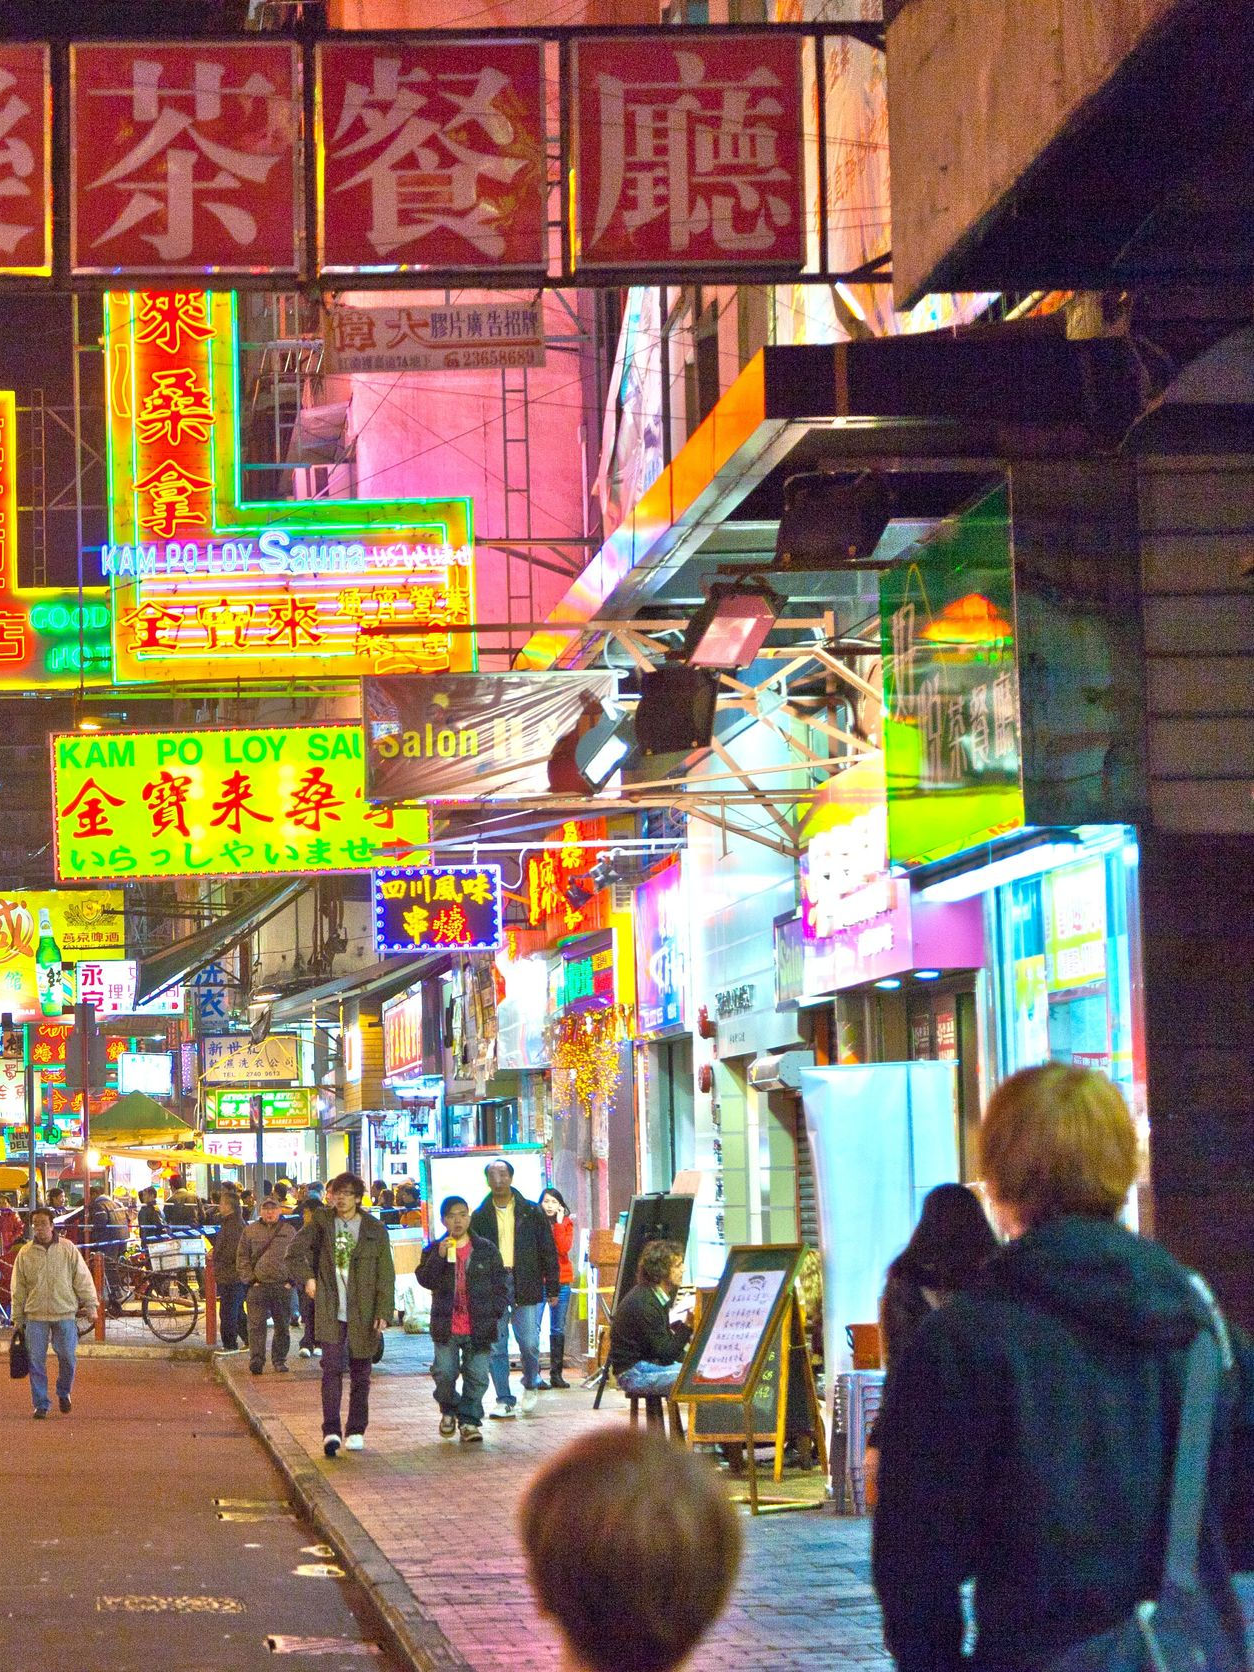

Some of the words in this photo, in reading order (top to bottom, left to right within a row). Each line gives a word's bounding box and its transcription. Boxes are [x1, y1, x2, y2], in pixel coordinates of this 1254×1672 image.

[101, 545, 156, 575] KAM
[166, 545, 198, 573] PO
[207, 544, 253, 573] LOY
[258, 530, 366, 574] Sauna
[60, 737, 135, 770] KAM
[158, 737, 203, 767] PO
[225, 735, 287, 765] LOY
[381, 874, 493, 904] 四川風味
[62, 931, 120, 943] 燕京啤酒
[403, 904, 471, 945] 串燒
